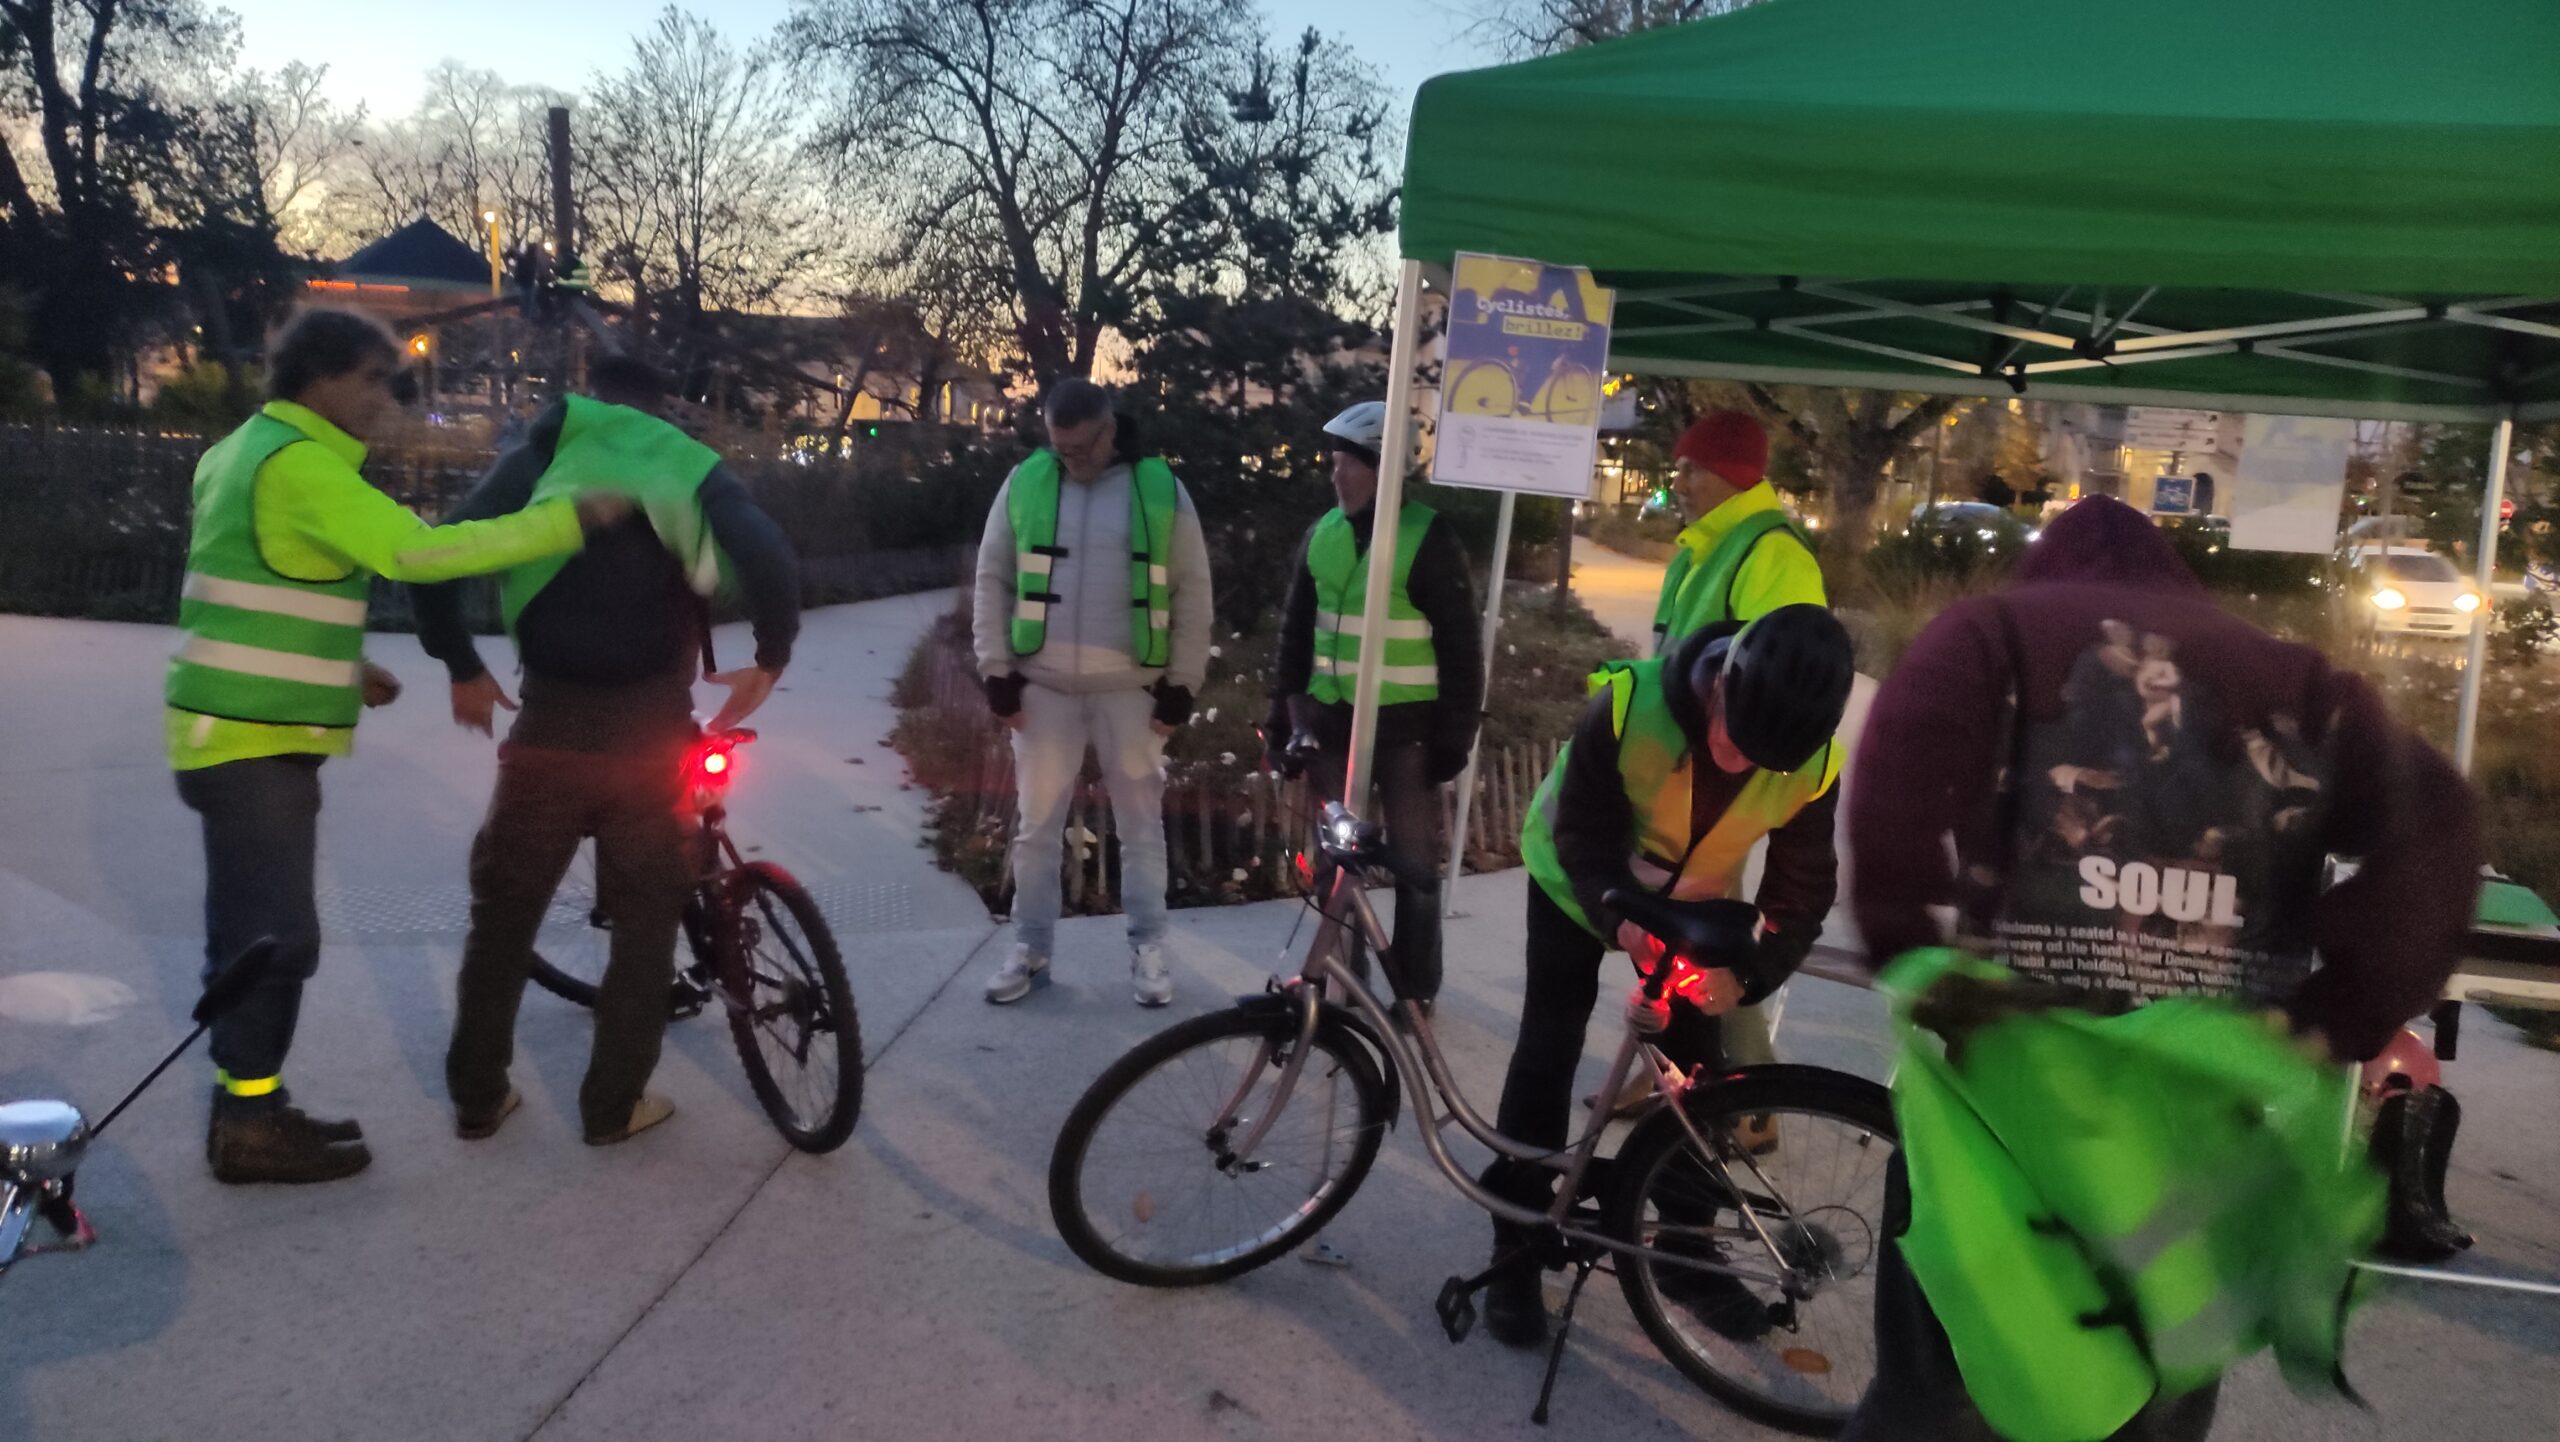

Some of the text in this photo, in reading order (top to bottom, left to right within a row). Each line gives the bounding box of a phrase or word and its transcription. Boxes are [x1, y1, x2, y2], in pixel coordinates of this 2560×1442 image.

[2079, 855, 2243, 926] SOUL
[2070, 924, 2114, 941] seated
[2010, 939, 2043, 953] wave
[2066, 941, 2088, 955] the
[2091, 941, 2122, 957] hand
[2049, 957, 2074, 970] and
[2077, 957, 2126, 977] holding
[2175, 969, 2196, 984] The
[2093, 977, 2103, 989] a
